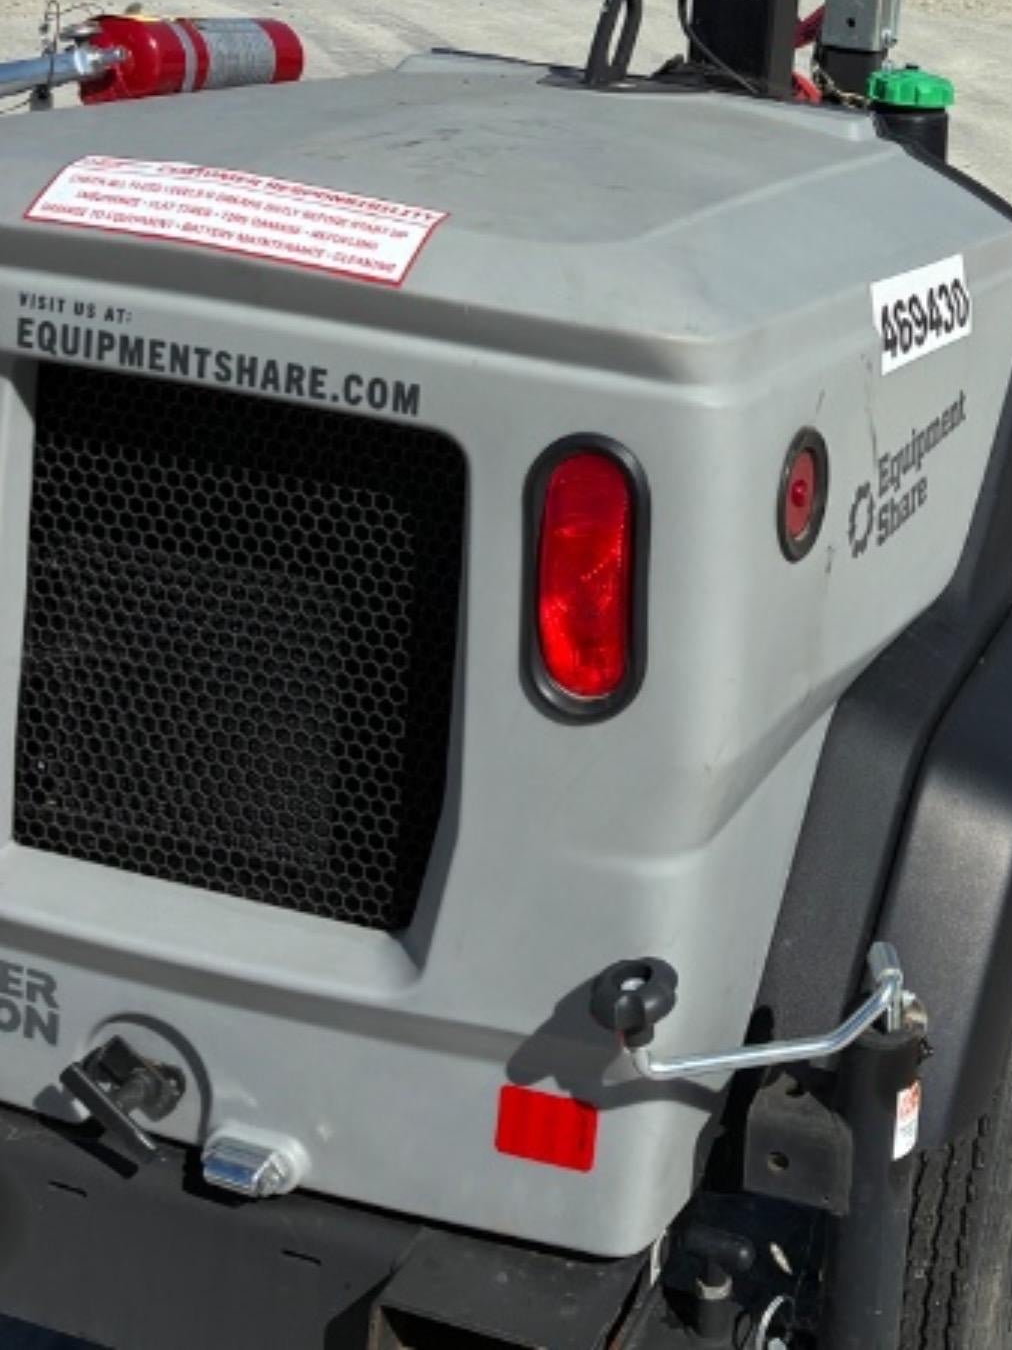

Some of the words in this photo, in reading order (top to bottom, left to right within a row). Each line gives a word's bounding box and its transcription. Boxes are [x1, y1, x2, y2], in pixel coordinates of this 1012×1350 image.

[18, 291, 66, 313] VISIT
[74, 300, 96, 319] US
[104, 305, 132, 325] AT:
[880, 278, 970, 357] 469430
[17, 316, 422, 416] EQUIPMENTSHARE.COM
[878, 389, 966, 498] Equipment
[876, 475, 928, 547] Share
